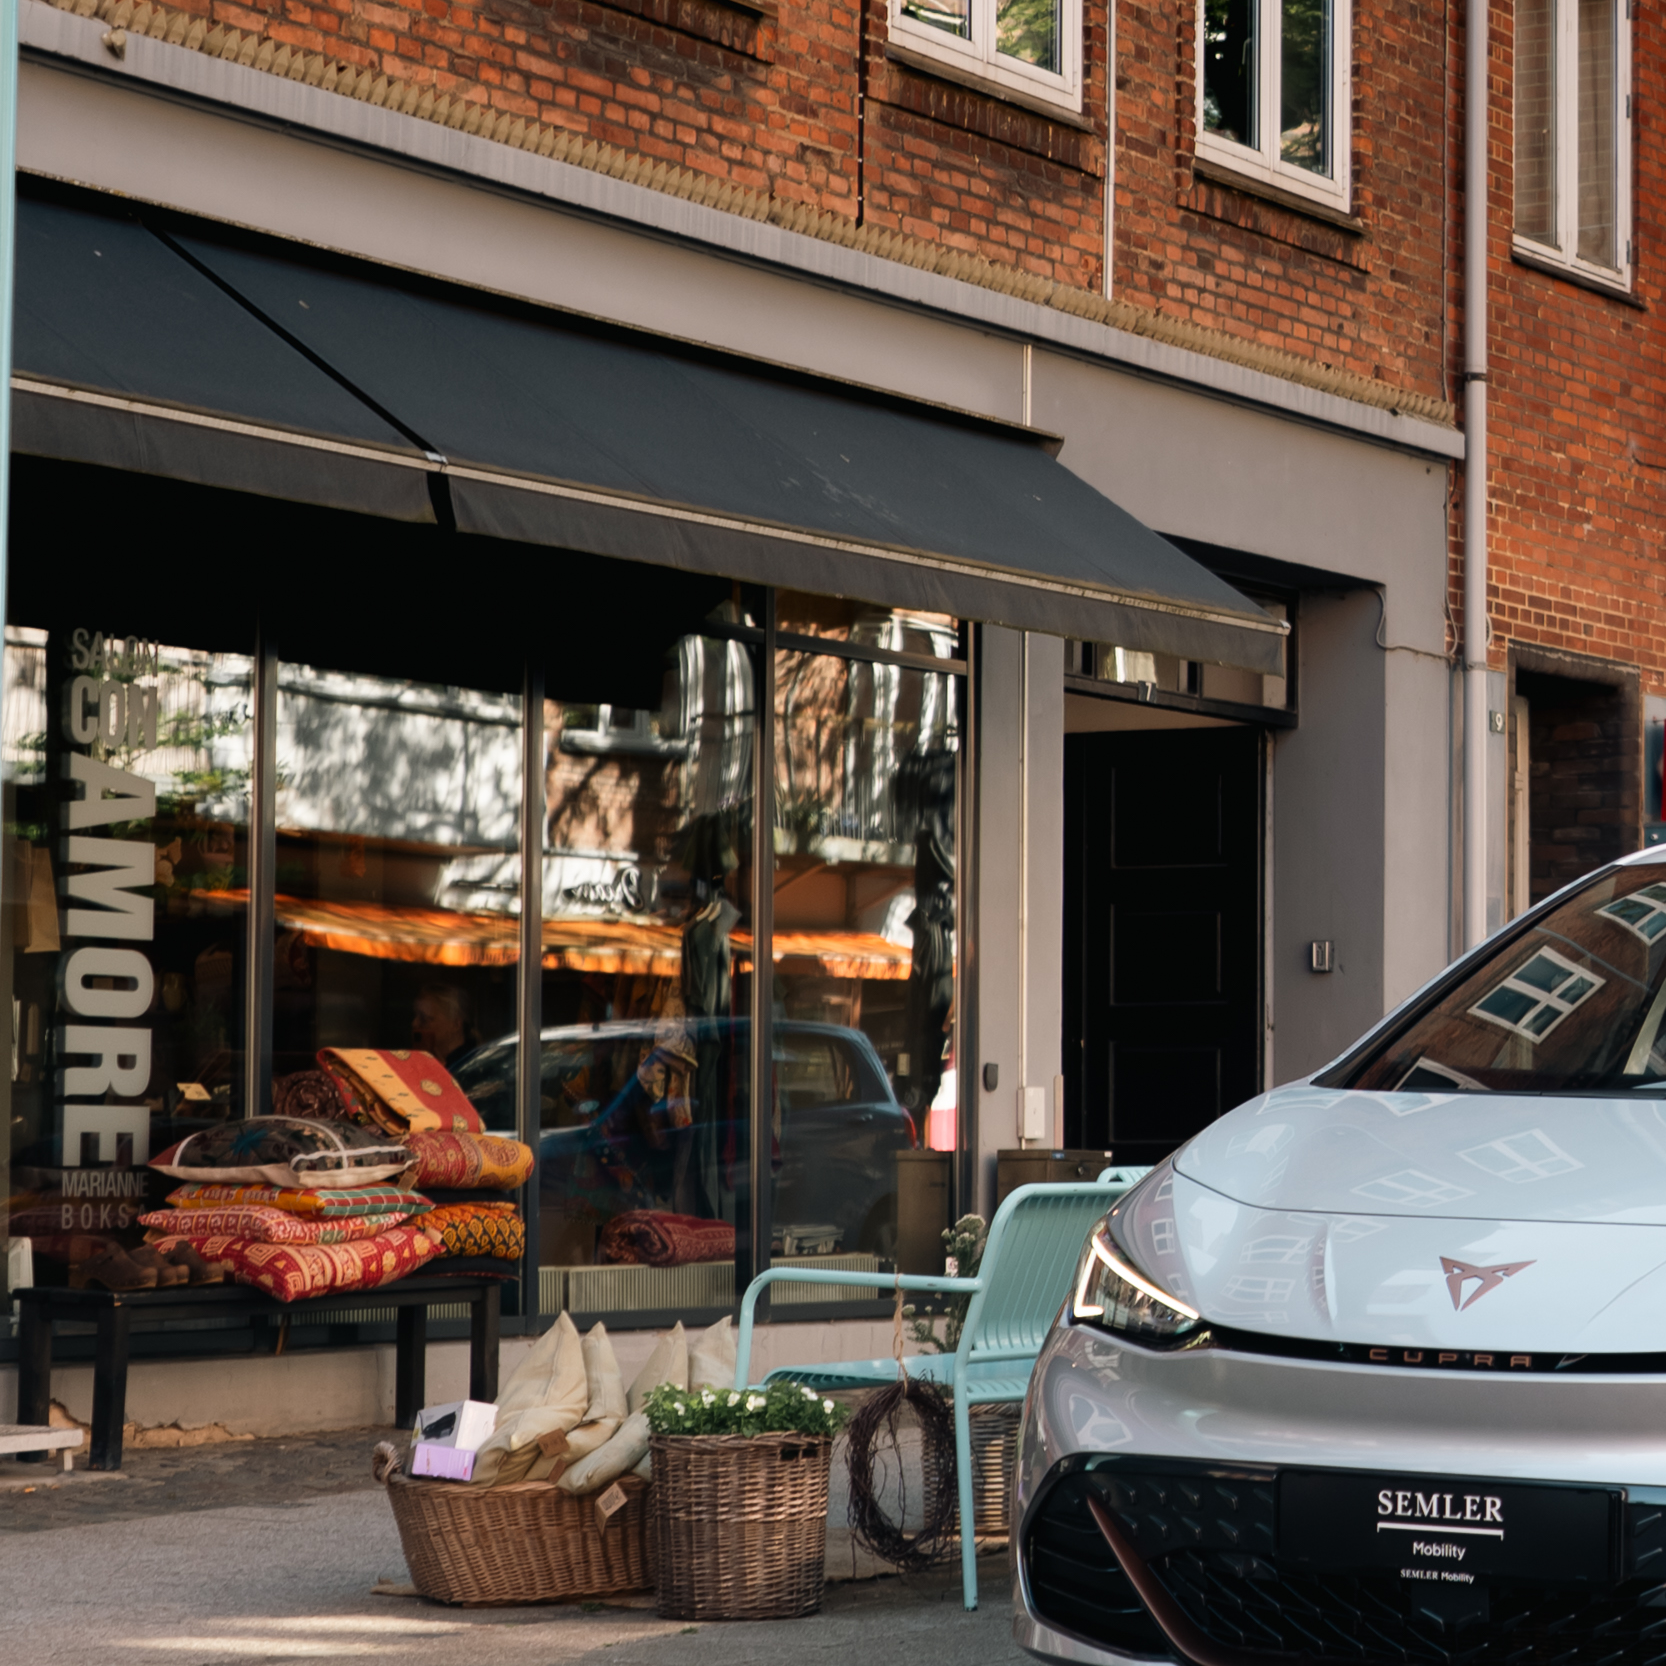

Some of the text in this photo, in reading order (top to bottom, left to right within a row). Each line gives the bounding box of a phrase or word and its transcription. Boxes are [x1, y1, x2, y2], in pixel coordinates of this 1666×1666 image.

[72, 627, 159, 677] SALON
[1145, 681, 1153, 701] 7
[70, 675, 157, 750] CON
[1495, 713, 1503, 732] 9
[62, 751, 156, 1167] AMORE
[62, 1171, 149, 1197] MARIANNE
[1369, 1348, 1531, 1367] CUPRA
[1377, 1489, 1503, 1522] SEMLER
[1412, 1540, 1466, 1561] Mobility
[1400, 1568, 1475, 1584] SEMLER Mobility
